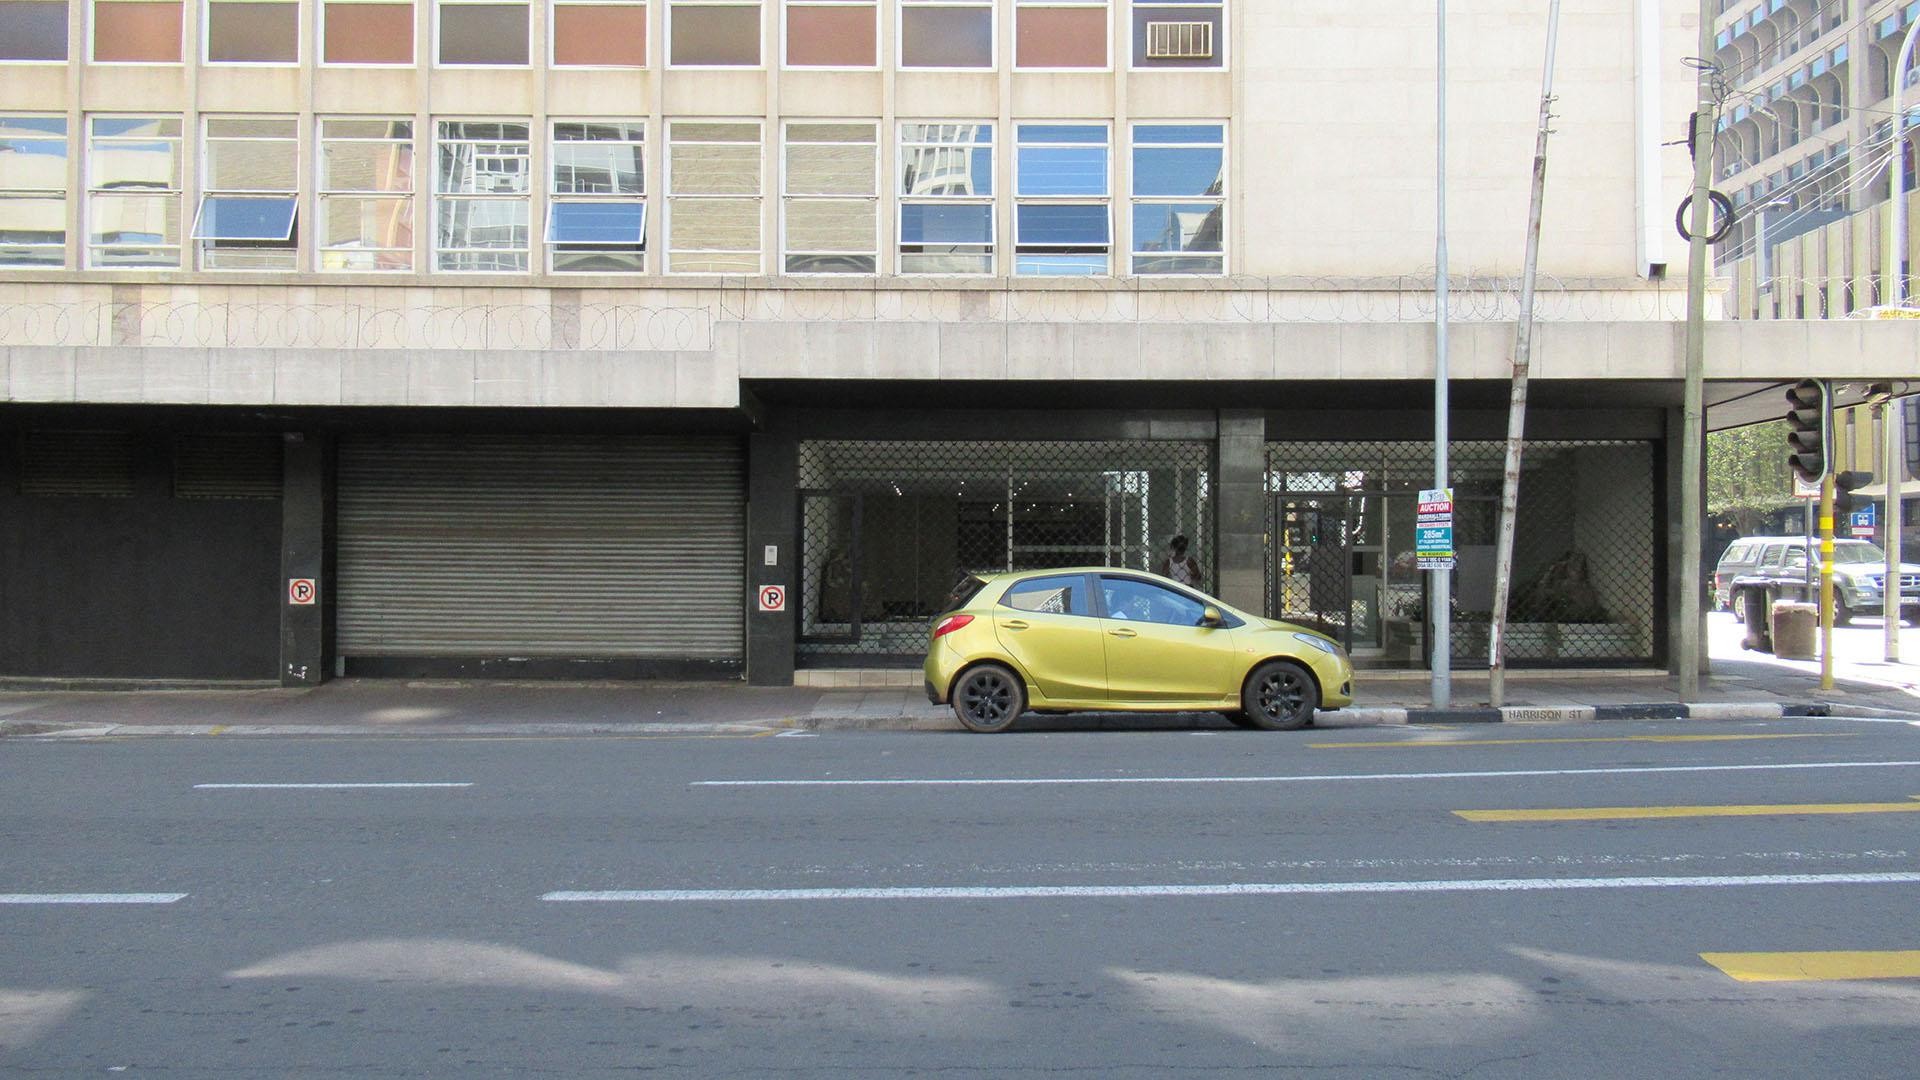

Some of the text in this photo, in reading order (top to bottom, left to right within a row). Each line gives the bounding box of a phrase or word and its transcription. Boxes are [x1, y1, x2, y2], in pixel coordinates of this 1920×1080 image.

[1420, 502, 1450, 512] AUCTION
[1508, 709, 1583, 719] HARRISON ST
